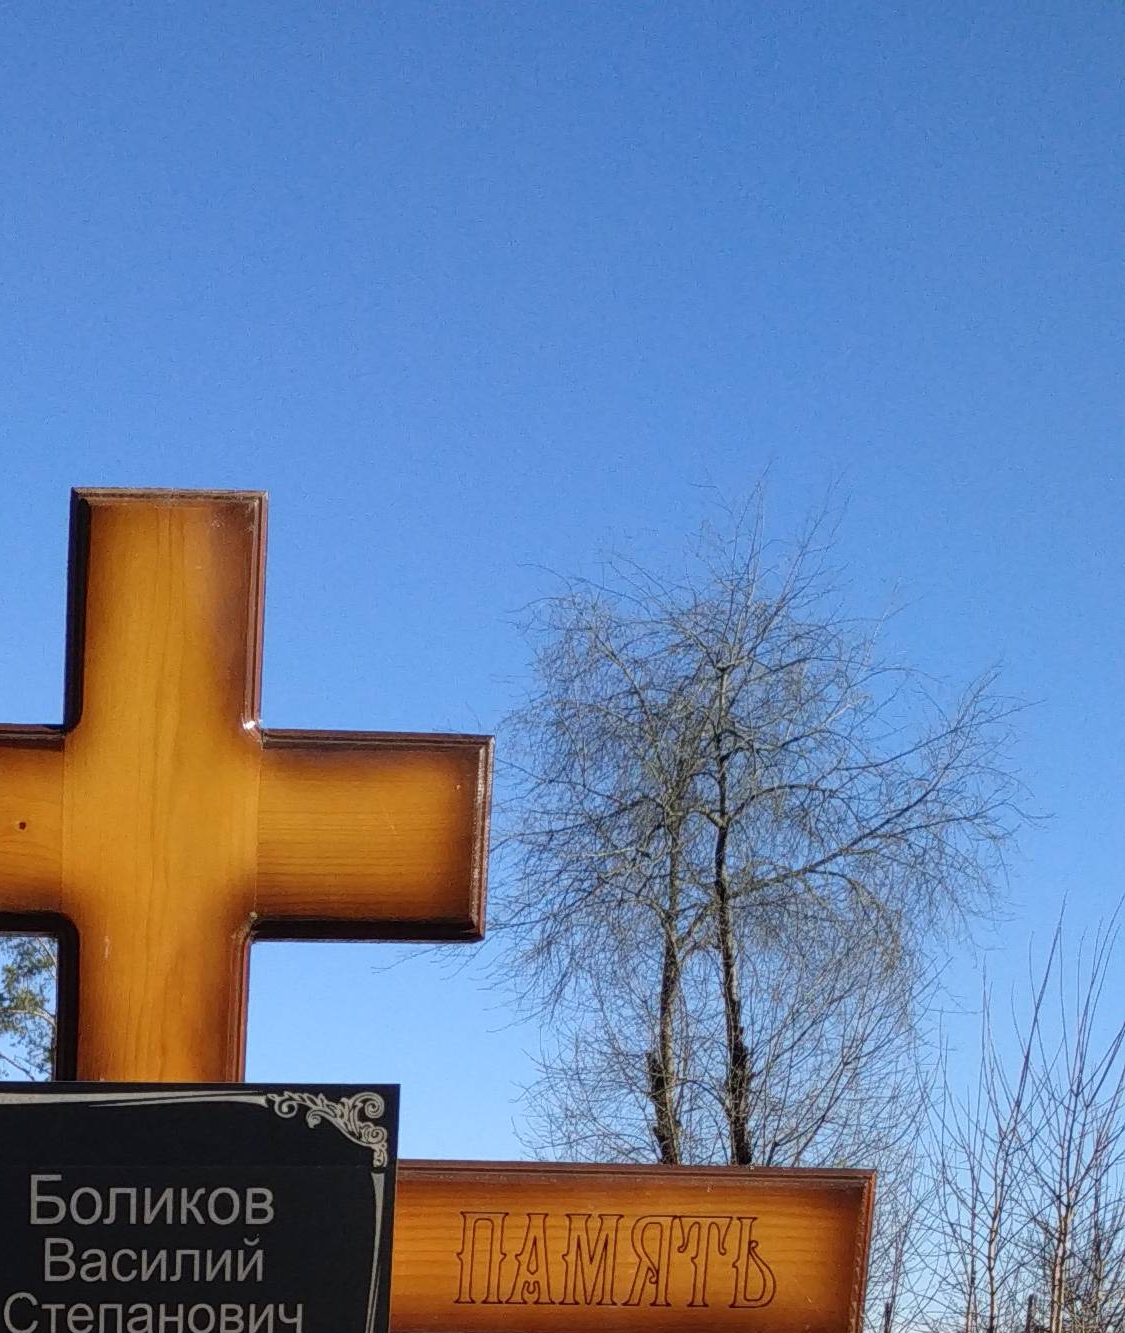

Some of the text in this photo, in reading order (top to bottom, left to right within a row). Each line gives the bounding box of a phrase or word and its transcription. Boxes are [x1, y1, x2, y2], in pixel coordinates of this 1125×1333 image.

[30, 1174, 274, 1225] Боликов
[44, 1234, 263, 1282] Василий
[454, 1211, 776, 1308] ПАМЯТЬ
